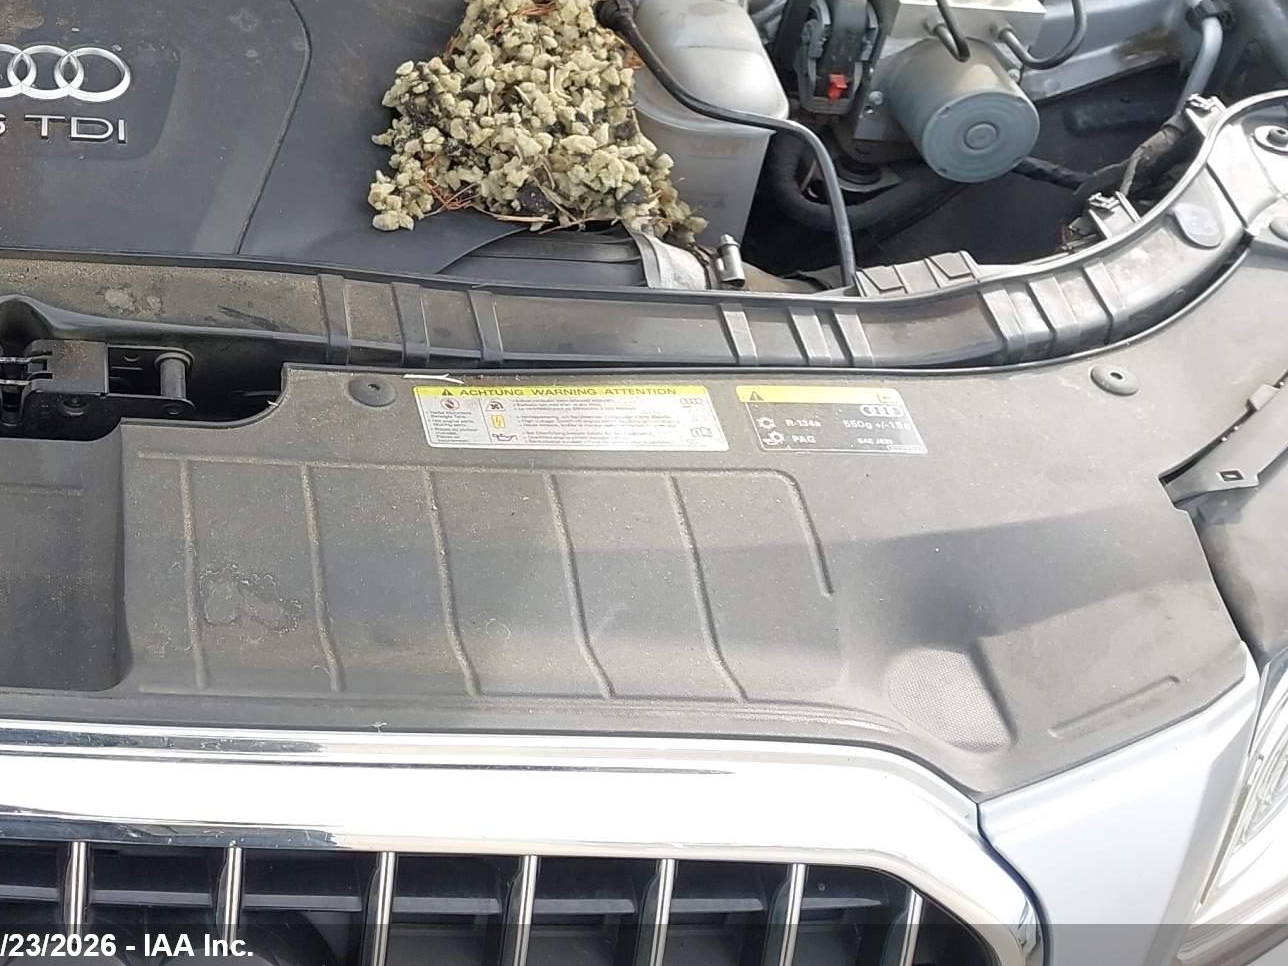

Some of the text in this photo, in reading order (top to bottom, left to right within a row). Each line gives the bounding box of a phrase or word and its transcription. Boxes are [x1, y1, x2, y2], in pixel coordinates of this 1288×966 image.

[24, 114, 127, 144] TDI
[460, 387, 677, 397] ACHTUNG WARNING ATTENTION
[792, 434, 817, 443] PAG
